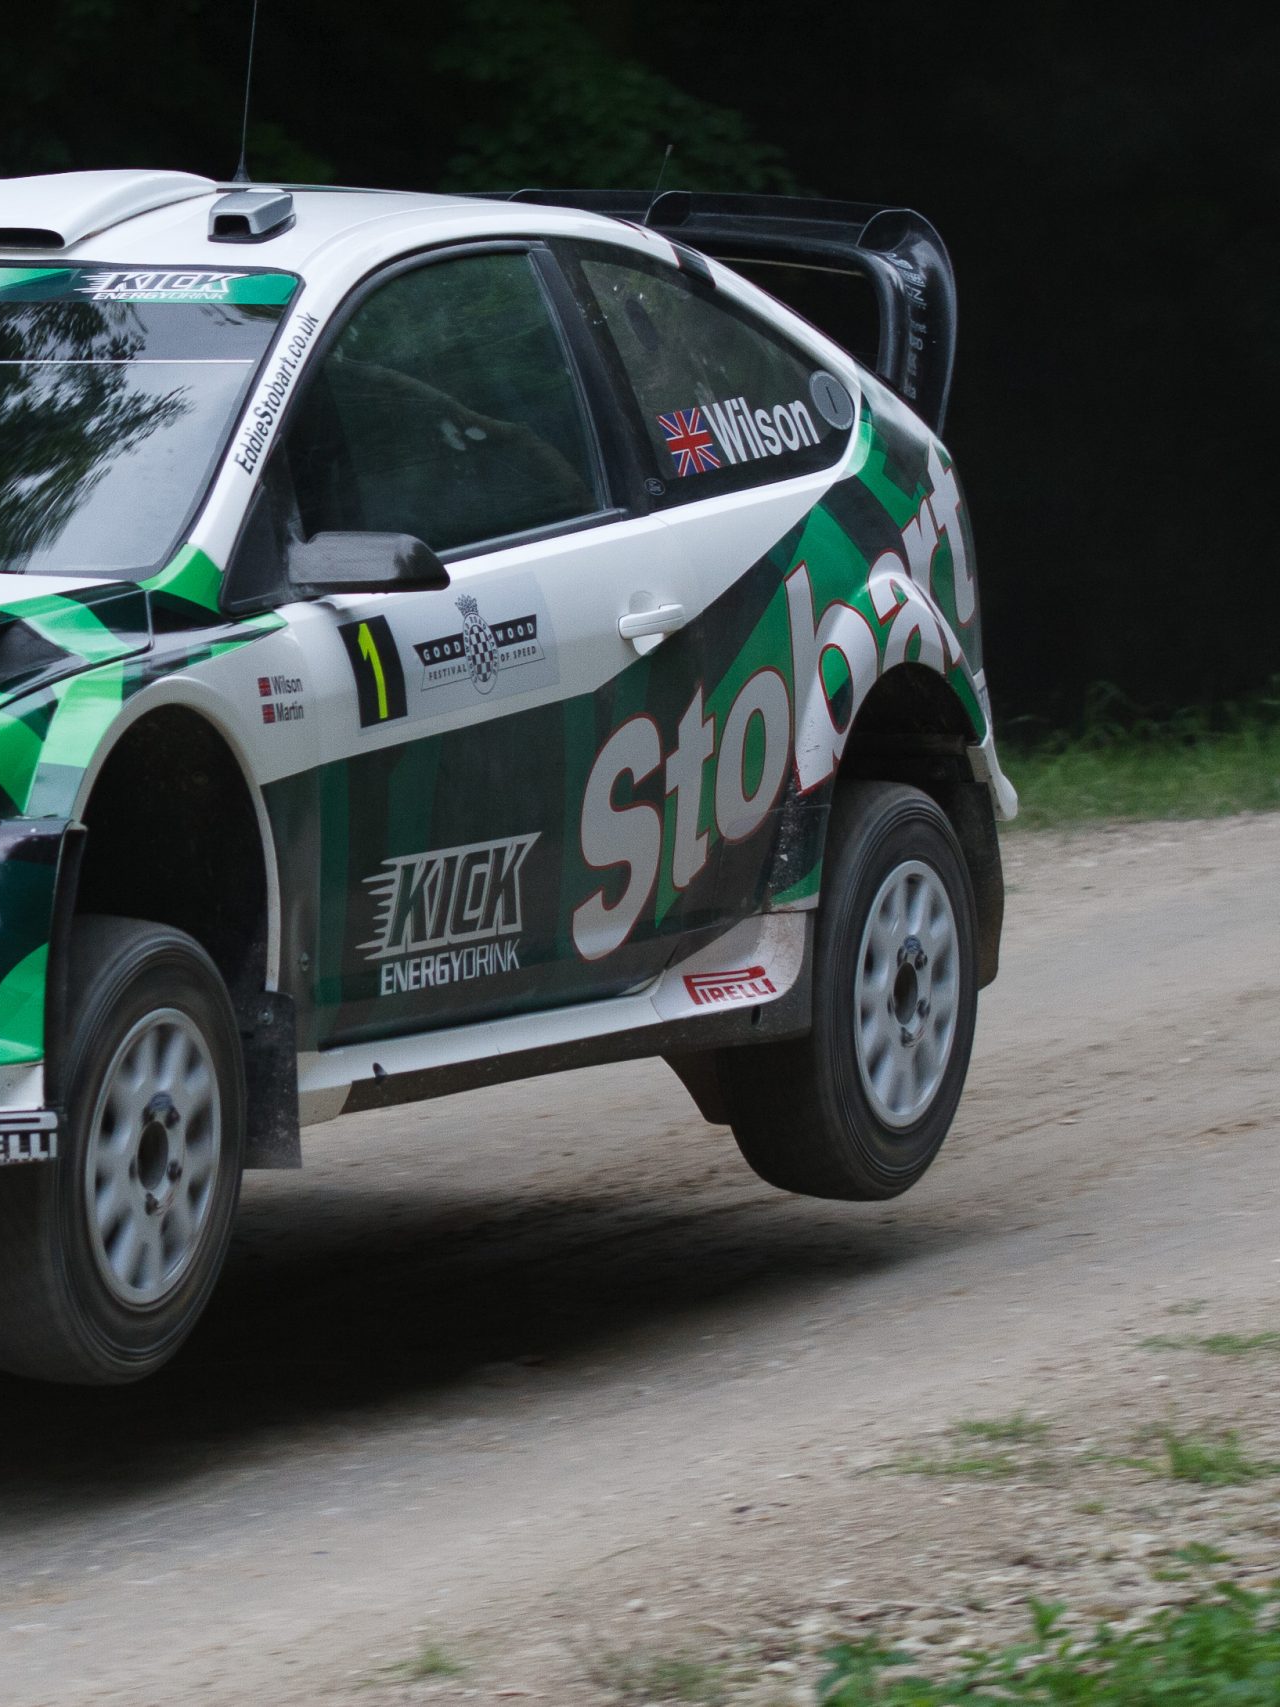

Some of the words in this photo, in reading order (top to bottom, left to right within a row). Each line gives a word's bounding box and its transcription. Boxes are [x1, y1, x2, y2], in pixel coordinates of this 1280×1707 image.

[86, 272, 249, 293] KICK
[92, 292, 225, 301] ENERGYDRINK
[234, 312, 320, 476] EddieStobart.co.uk
[701, 396, 820, 465] Wilson
[271, 675, 303, 695] Wilson
[357, 623, 388, 719] 1
[428, 664, 467, 680] FESTIVAL
[500, 655, 510, 663] OF
[513, 646, 537, 659] SPEED
[275, 700, 304, 722] Martin
[572, 437, 979, 960] Stobart
[357, 832, 541, 960] KICK
[381, 939, 520, 996] ENERGYDRINK
[682, 965, 777, 1005] PIRELLI
